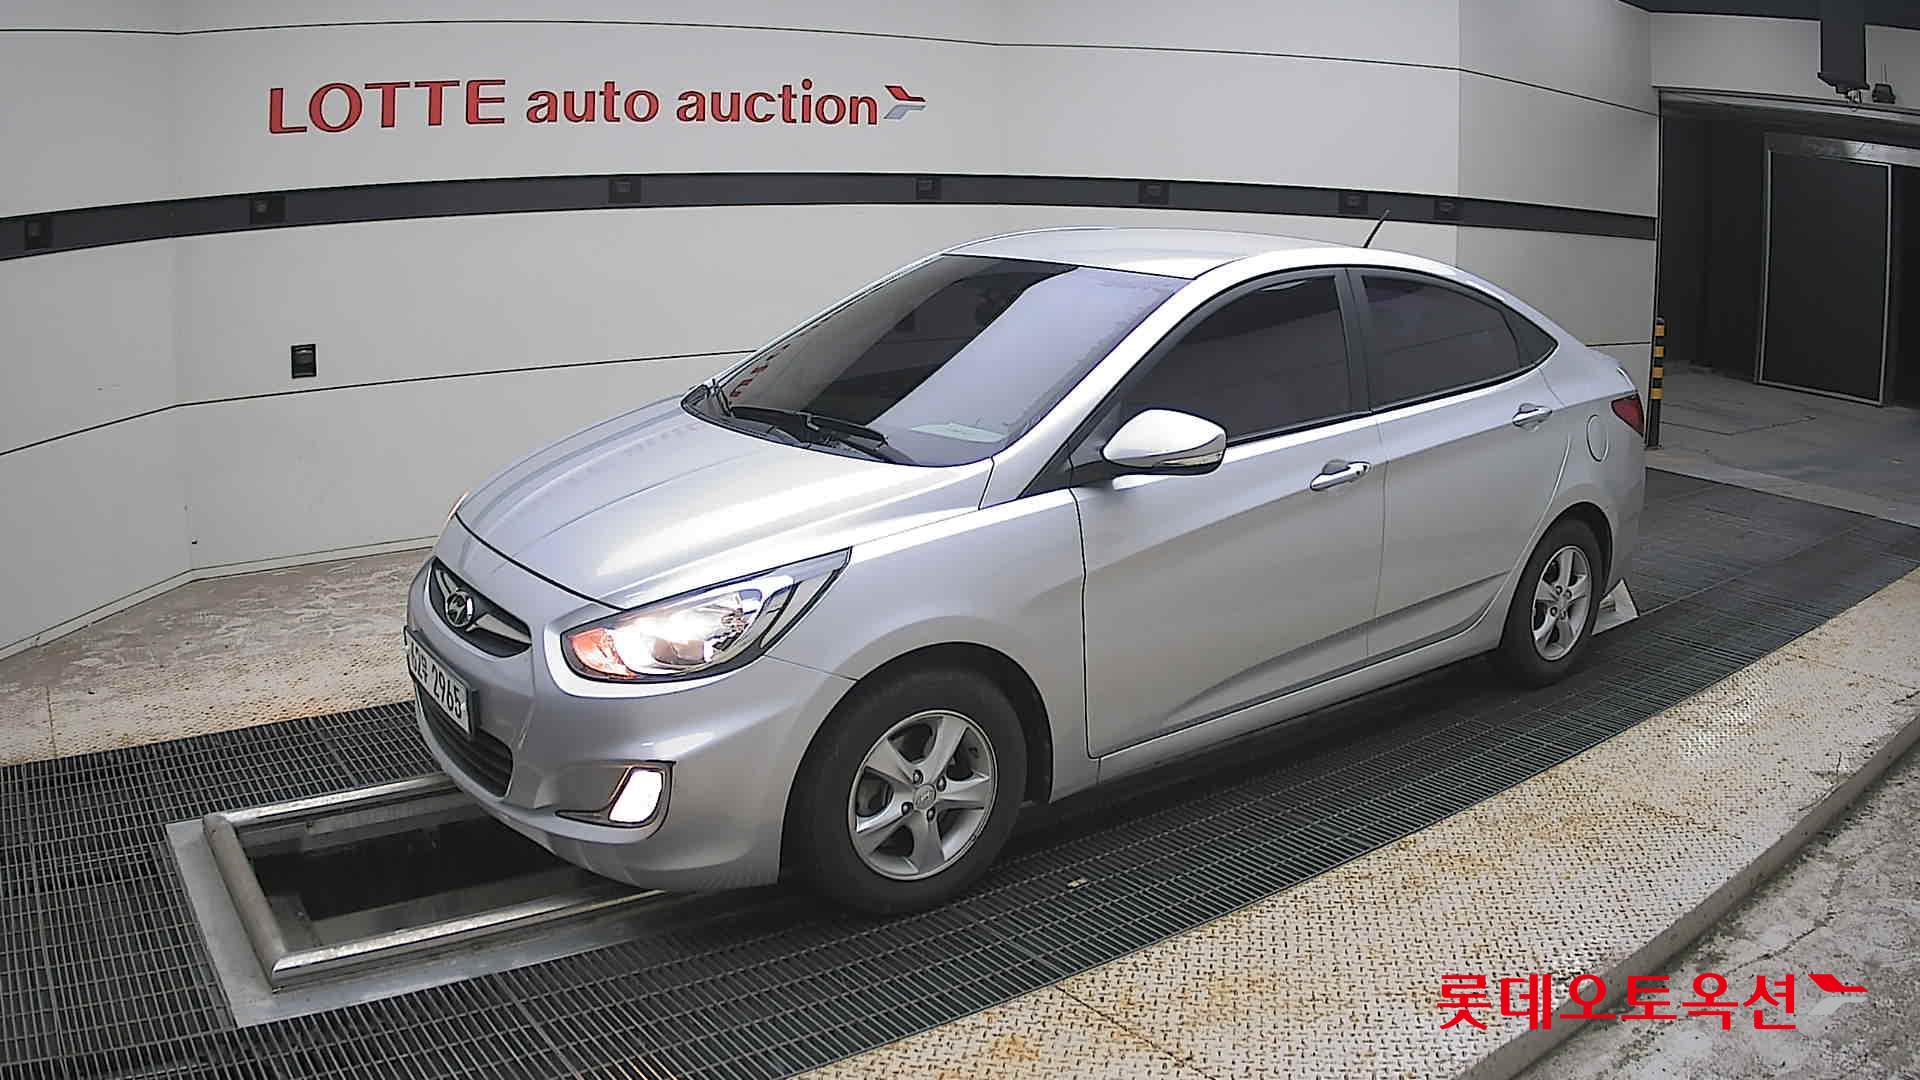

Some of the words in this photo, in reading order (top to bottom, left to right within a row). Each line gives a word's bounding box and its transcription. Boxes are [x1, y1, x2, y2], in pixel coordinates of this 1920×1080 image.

[268, 79, 506, 134] LOTTE
[526, 80, 661, 124] auto
[676, 79, 879, 125] auction
[431, 664, 462, 719] 2965
